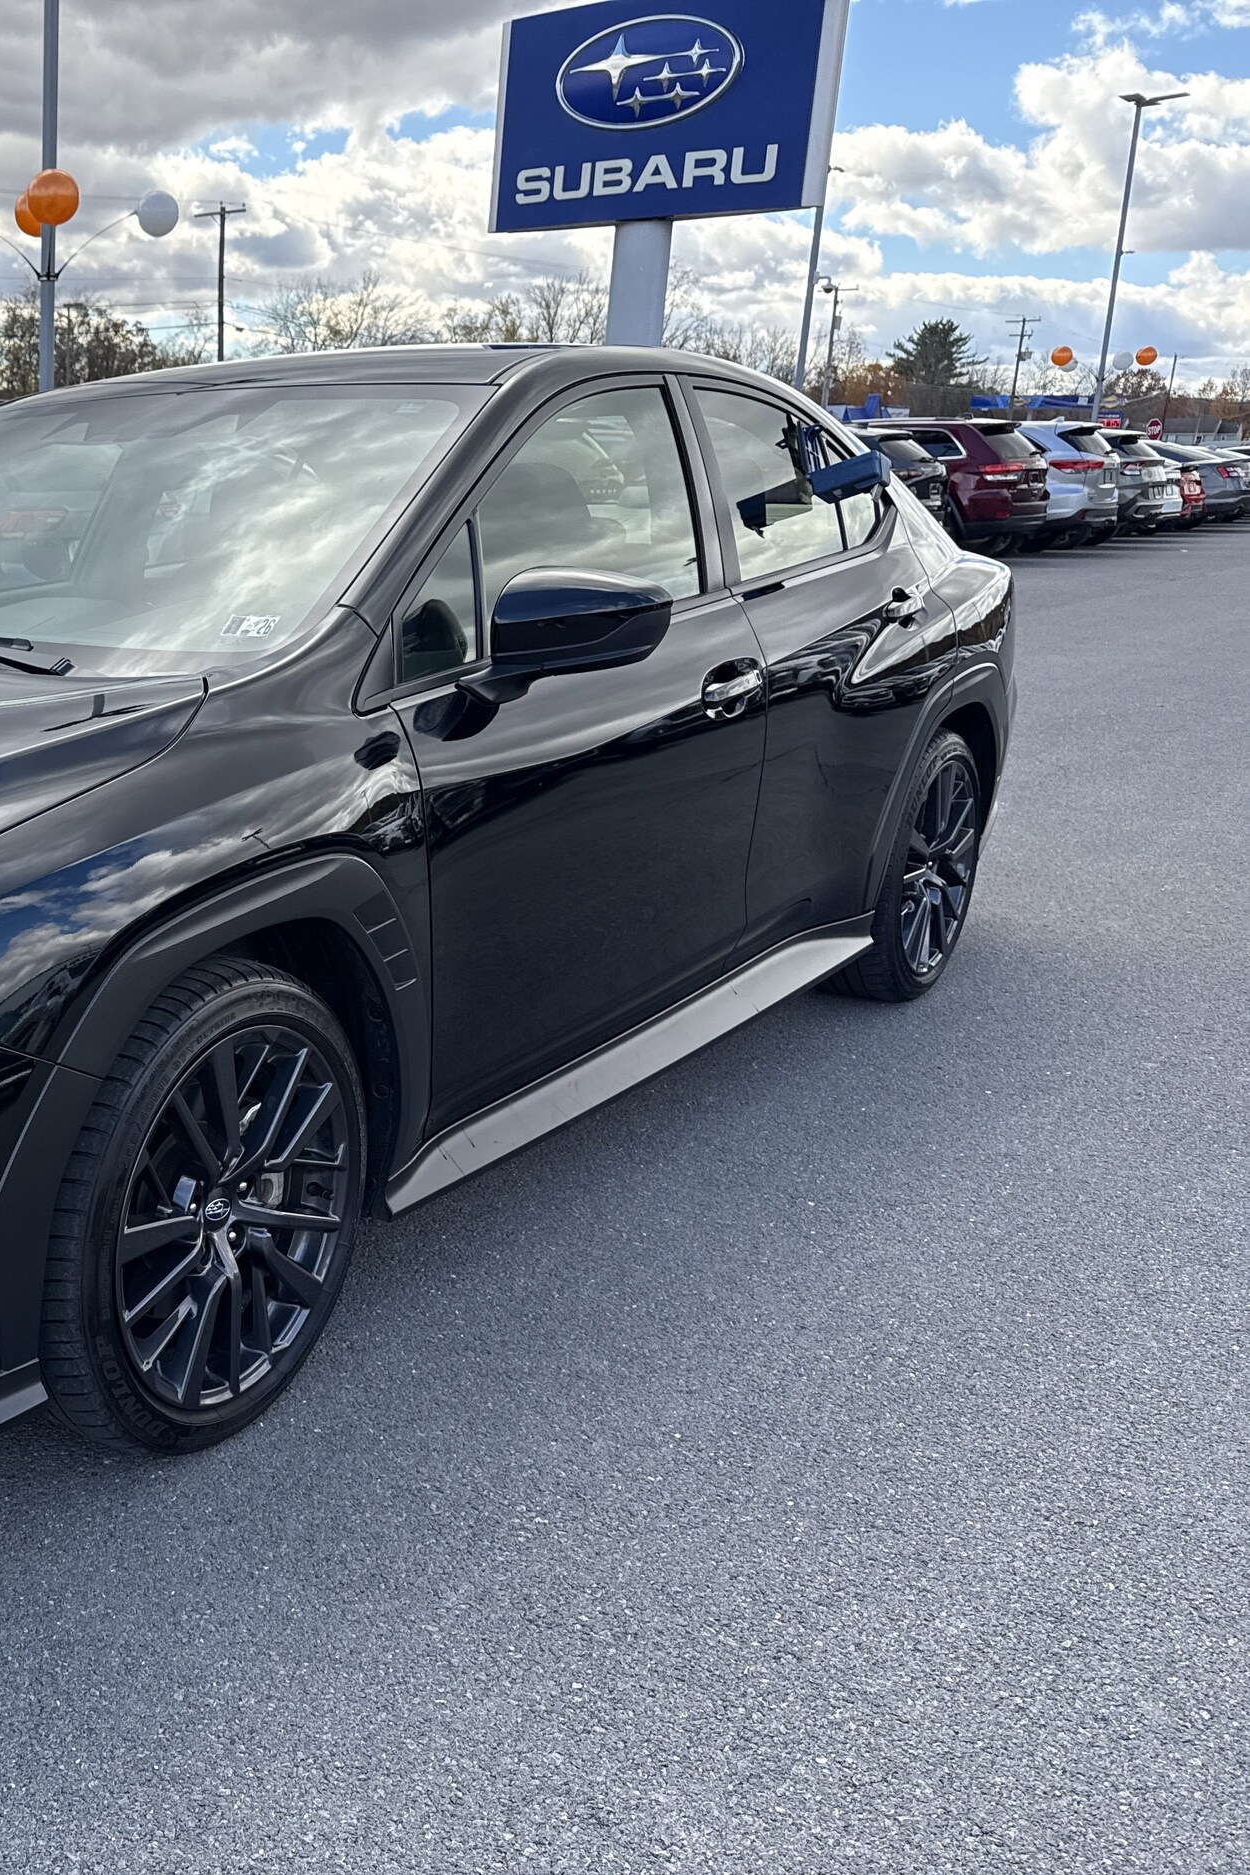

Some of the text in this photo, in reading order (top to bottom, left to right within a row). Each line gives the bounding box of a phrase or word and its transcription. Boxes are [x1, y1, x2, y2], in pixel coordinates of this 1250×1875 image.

[514, 143, 779, 206] SUBARU
[1148, 425, 1161, 435] STOP
[95, 1335, 170, 1437] DUNLOP
